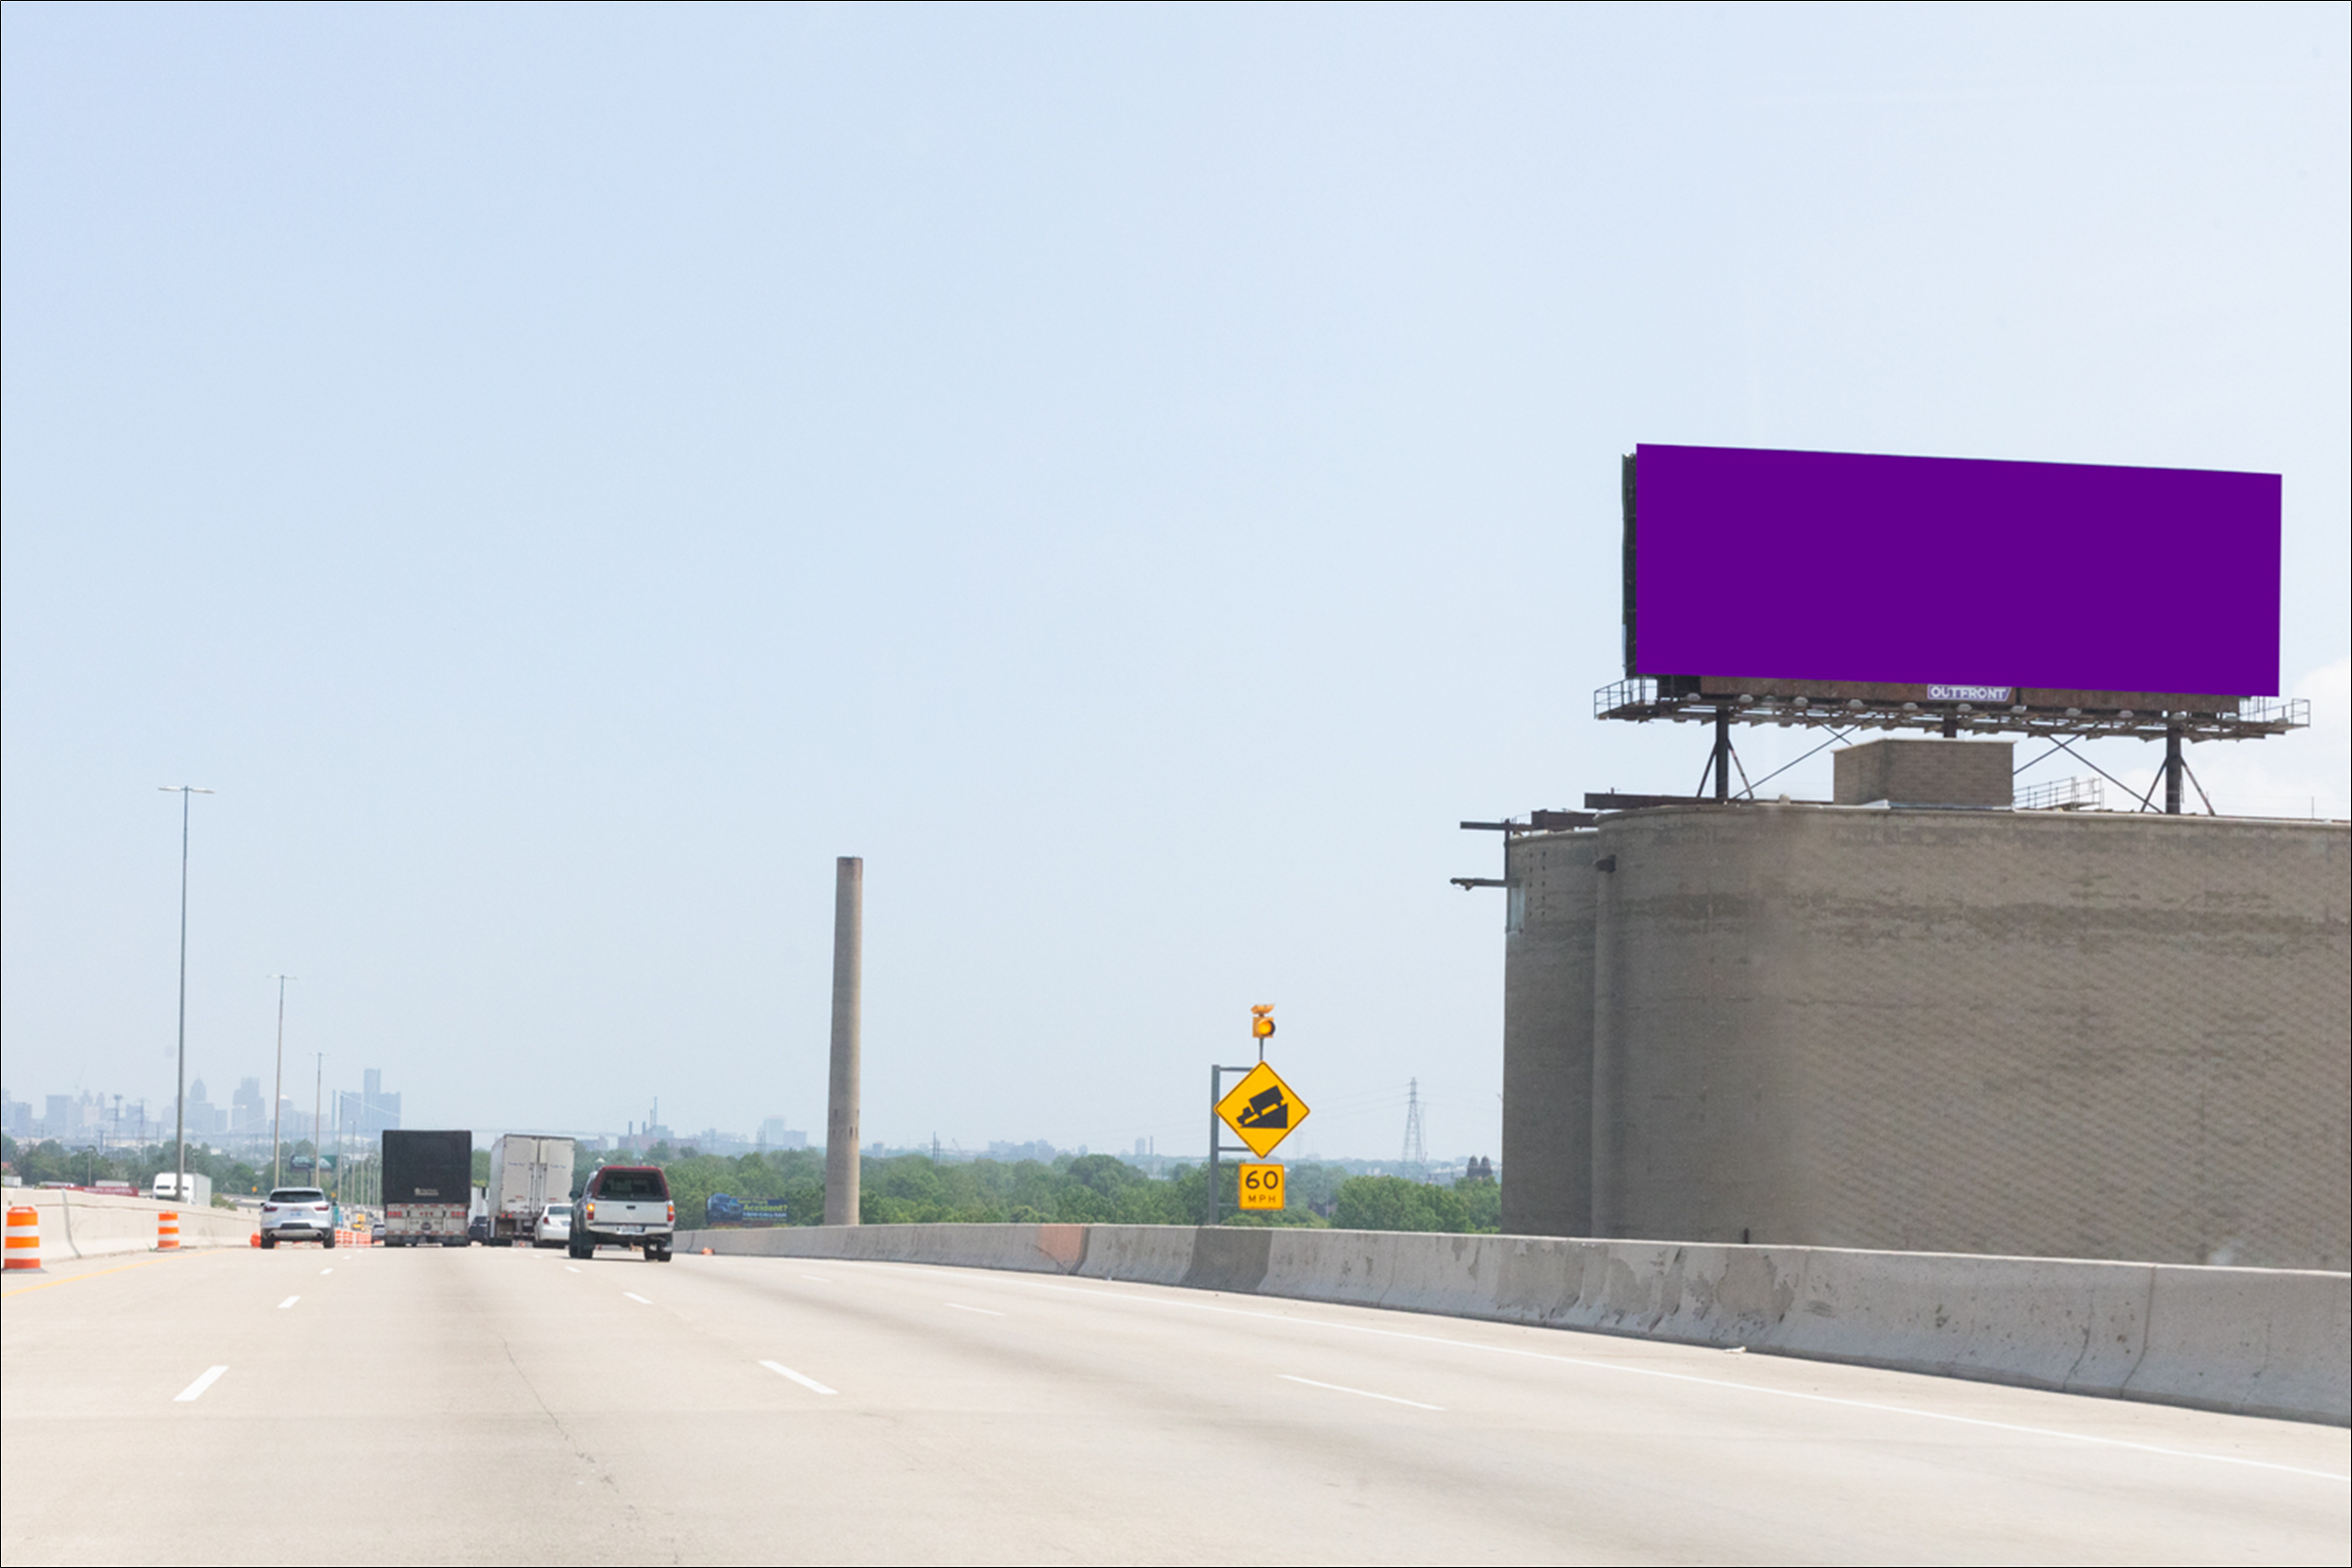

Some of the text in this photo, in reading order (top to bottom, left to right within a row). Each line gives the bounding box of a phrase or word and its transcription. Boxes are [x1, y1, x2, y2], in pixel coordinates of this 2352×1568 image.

[1931, 686, 2006, 700] OUTFRONT
[1246, 1170, 1279, 1190] 60
[1248, 1195, 1277, 1203] MPH
